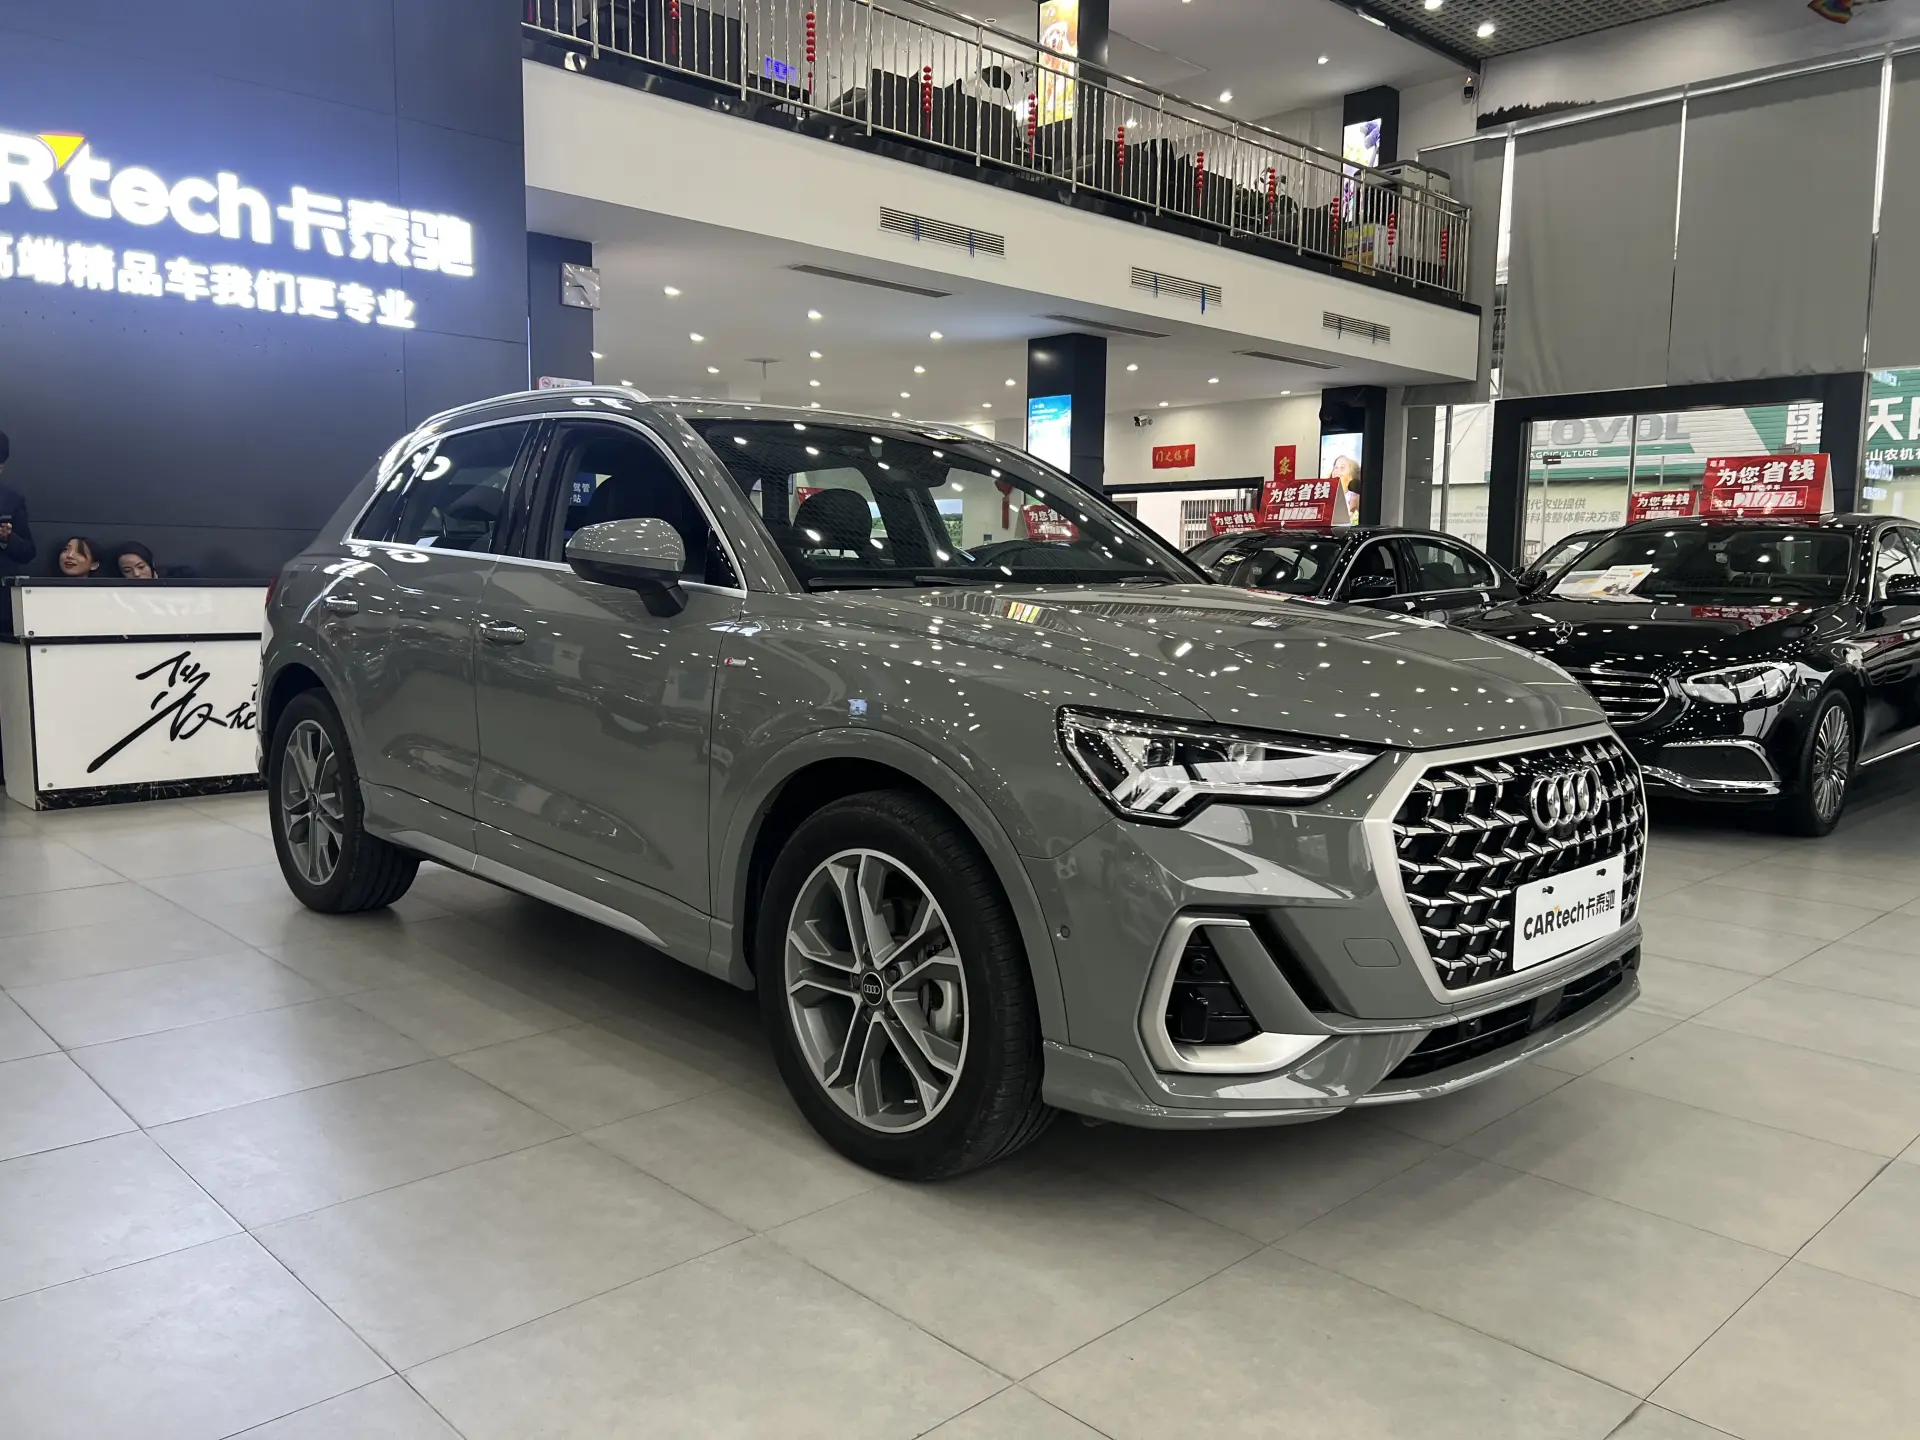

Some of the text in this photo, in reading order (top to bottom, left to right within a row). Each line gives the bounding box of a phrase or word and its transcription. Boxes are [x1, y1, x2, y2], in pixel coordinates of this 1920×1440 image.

[1532, 414, 1691, 446] LOVOL
[1866, 396, 1920, 441] 天
[1865, 447, 1920, 462] 山农机
[1715, 459, 1816, 487] 为您省钱
[1267, 482, 1331, 504] 为您省钱
[1636, 493, 1690, 508] 为您省钱
[1523, 900, 1585, 941] CARtech
